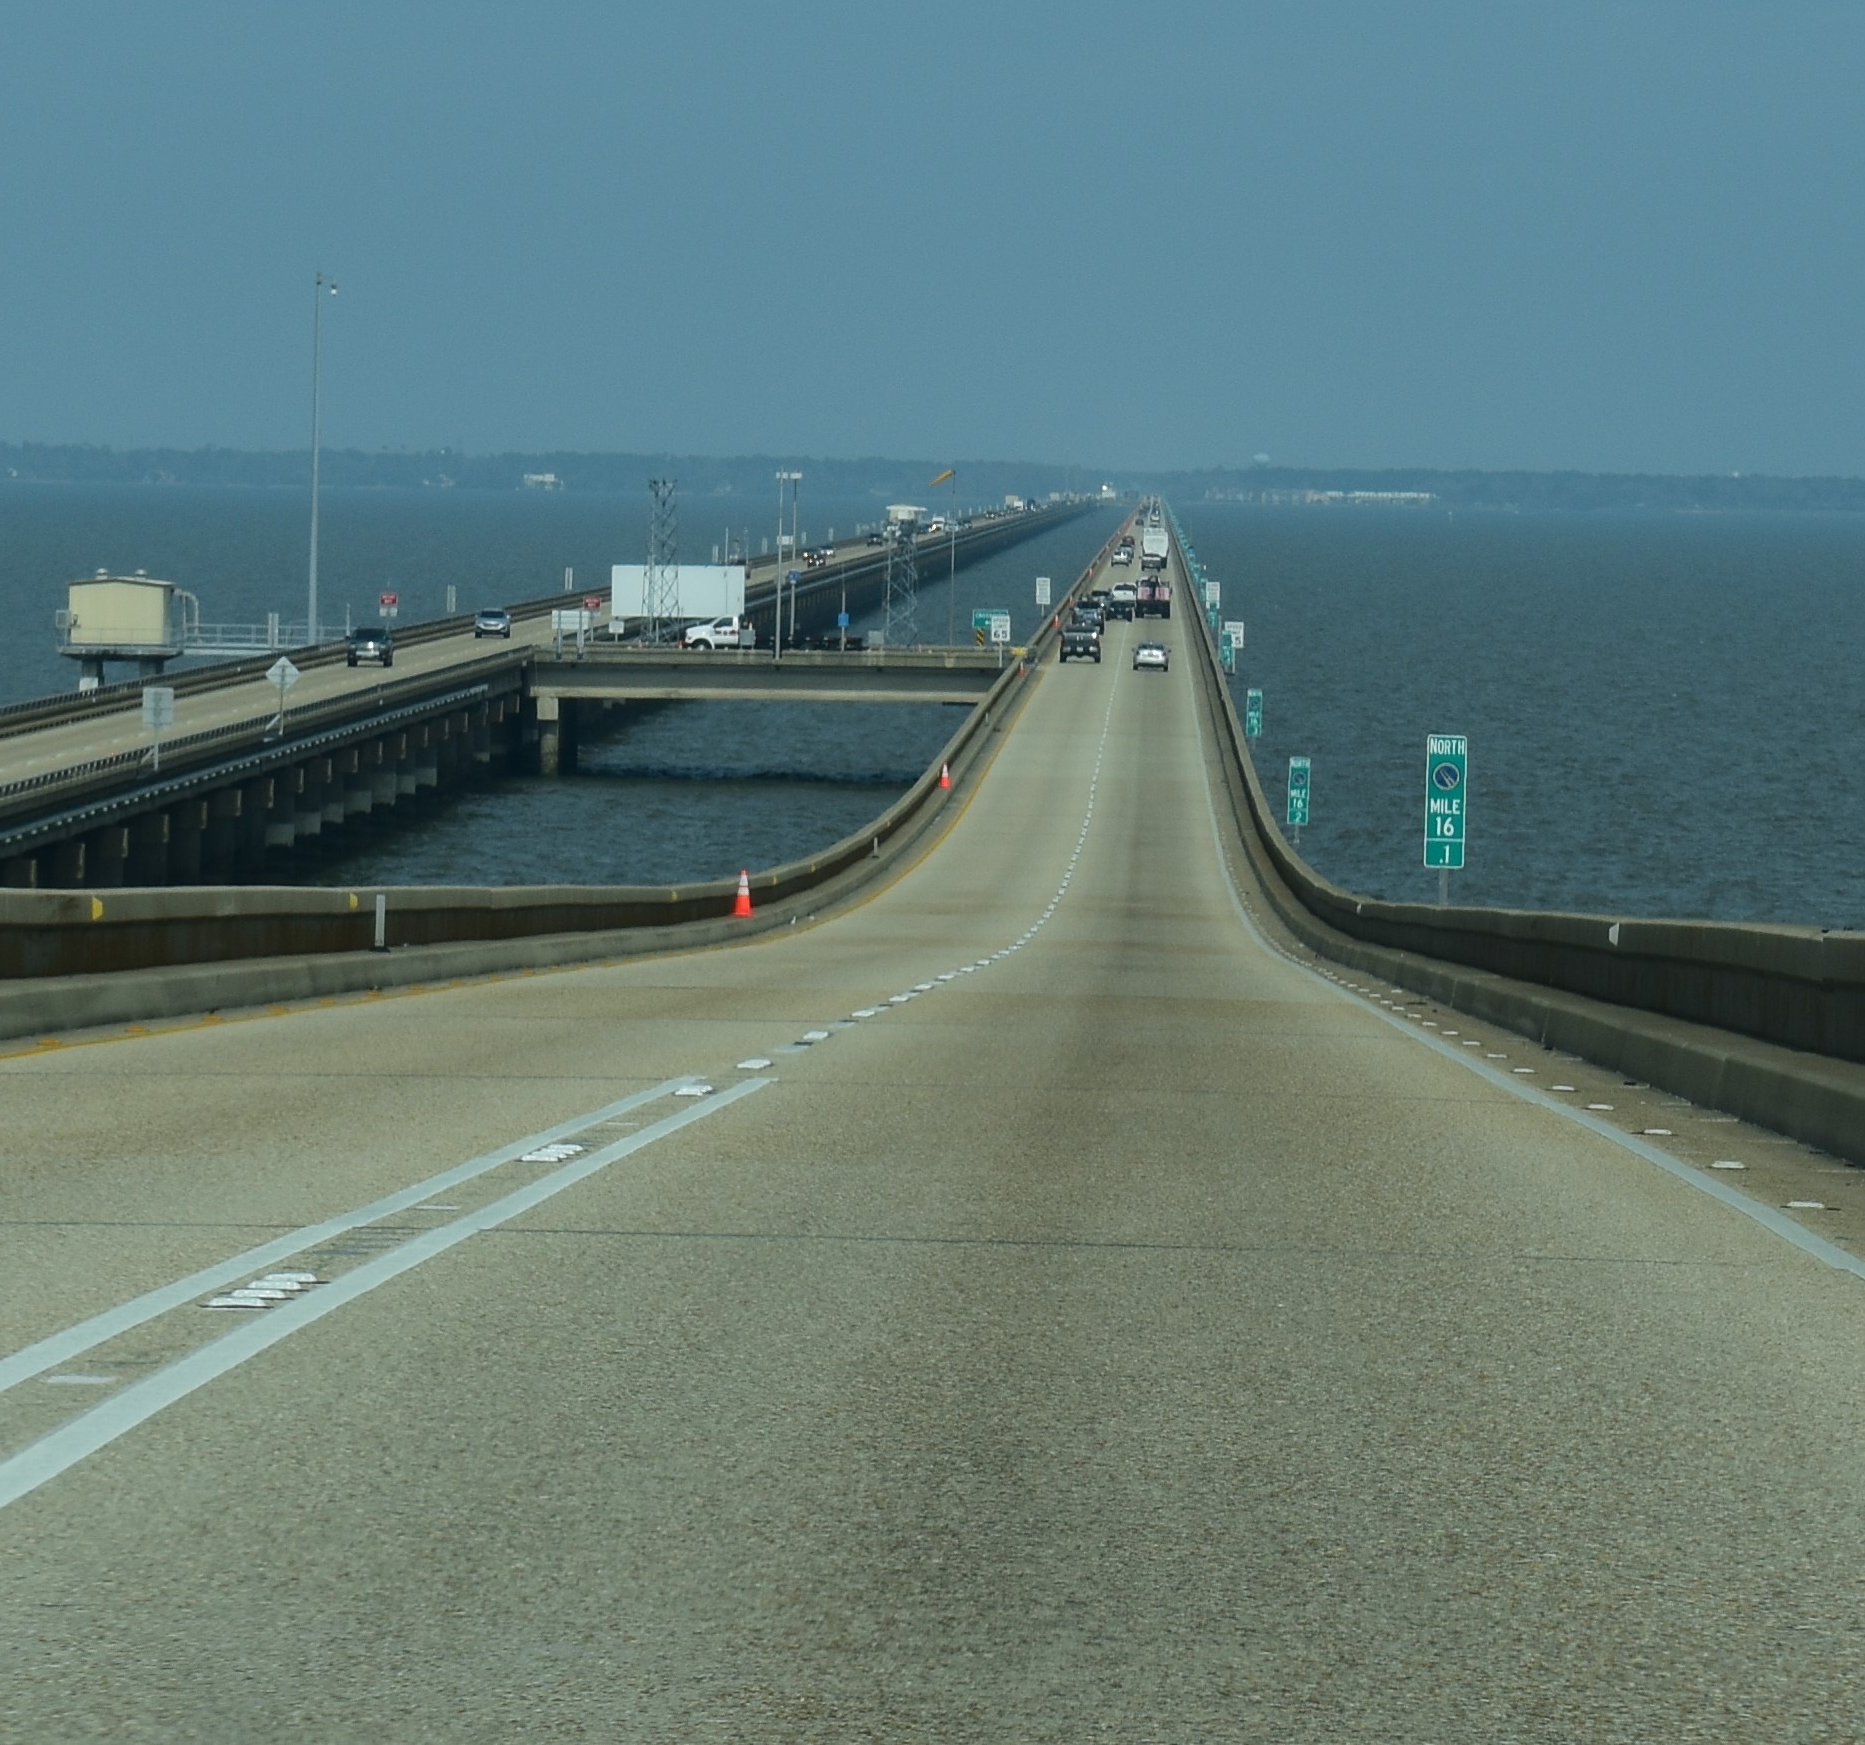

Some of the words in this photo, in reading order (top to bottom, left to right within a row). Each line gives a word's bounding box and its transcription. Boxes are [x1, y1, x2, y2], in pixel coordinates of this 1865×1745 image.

[993, 630, 1008, 639] 65
[1429, 739, 1465, 755] NORTH
[1290, 789, 1306, 798] MILE
[1293, 798, 1303, 808] 16
[1430, 798, 1461, 815] MILE
[1436, 816, 1454, 836] 16
[1439, 844, 1450, 864] .1
